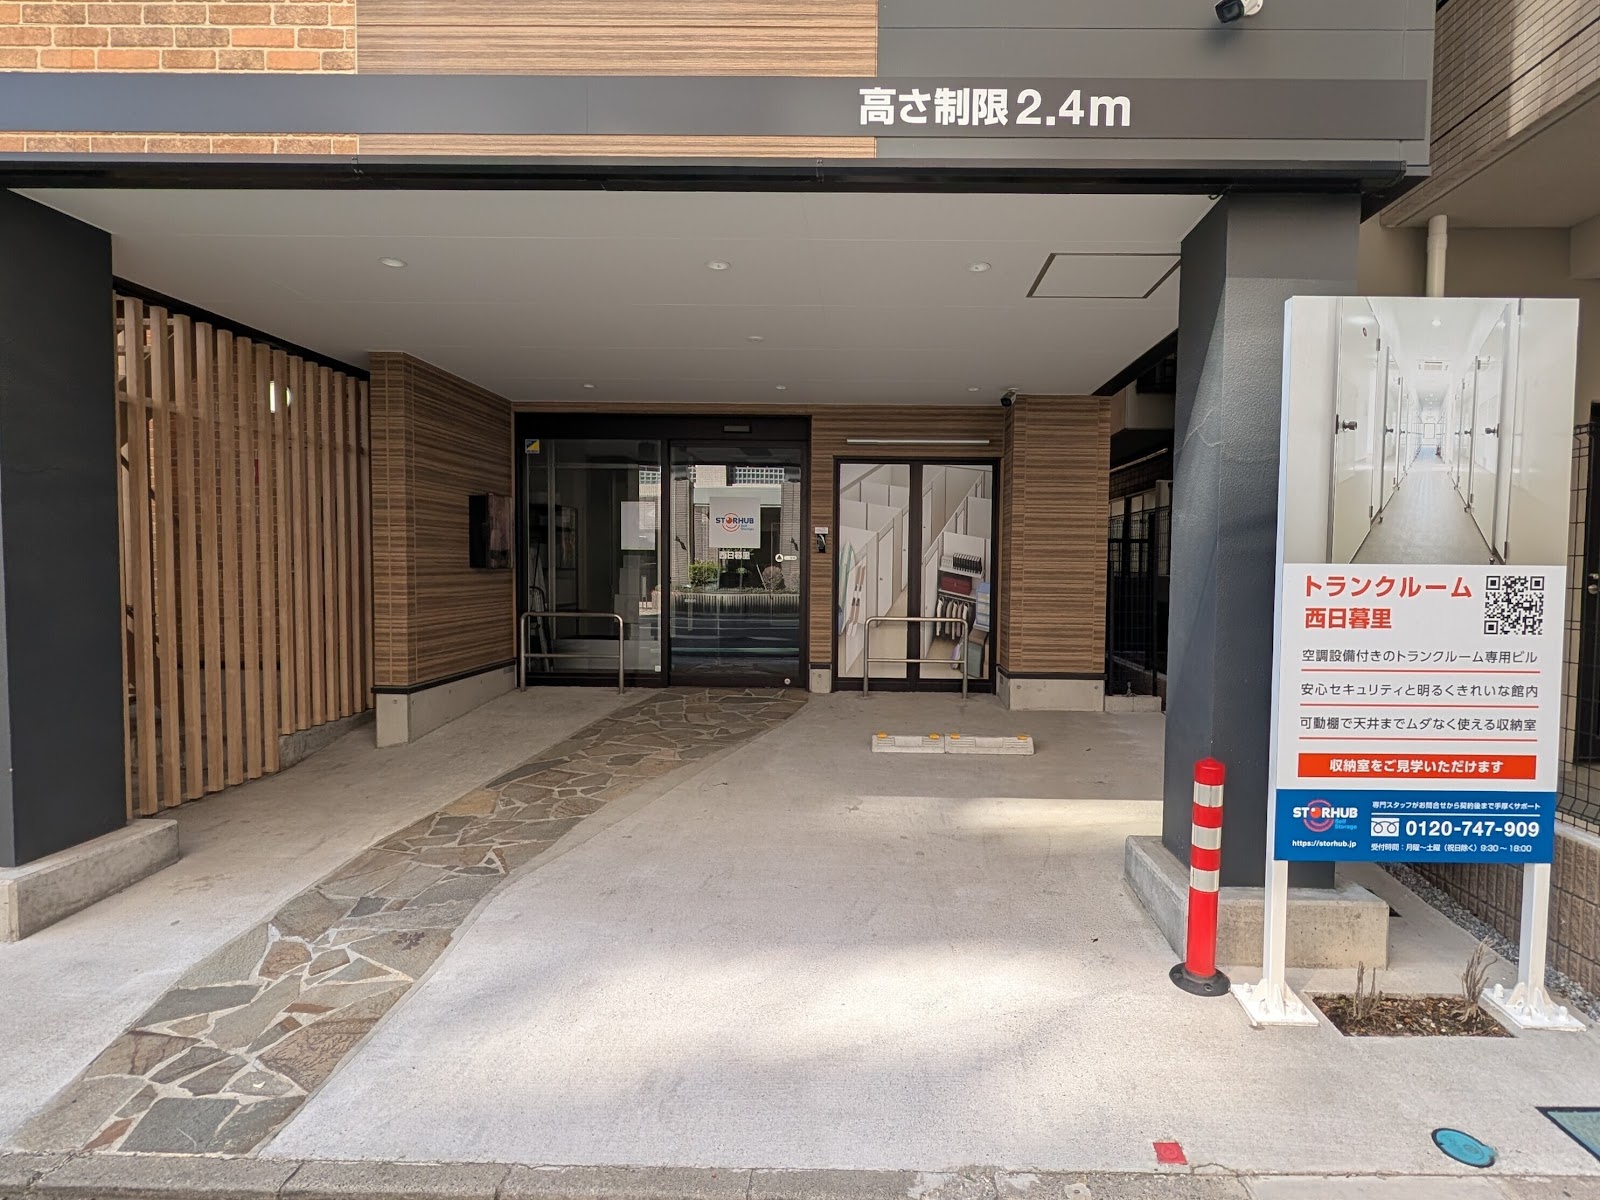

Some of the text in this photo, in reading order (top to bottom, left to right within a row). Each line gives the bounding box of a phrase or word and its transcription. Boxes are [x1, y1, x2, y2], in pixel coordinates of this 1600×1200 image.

[859, 87, 1131, 127] 高さ制限2.4m
[1305, 575, 1473, 598] トランクルーム
[1305, 607, 1392, 629] 西日暮里
[1301, 648, 1538, 664] 空調設備付きのトランクルーム専用ビル
[1300, 683, 1538, 698] 安心セキュリティと明るくきれいな館内
[1300, 716, 1537, 732] 可動棚で天井までムダなく使える収納室
[1329, 758, 1504, 774] 収納室をご見学いただけます
[1292, 806, 1358, 819] STORHUB
[1405, 820, 1540, 838] 0120-747-909
[1292, 839, 1357, 848] https://storhub.jp
